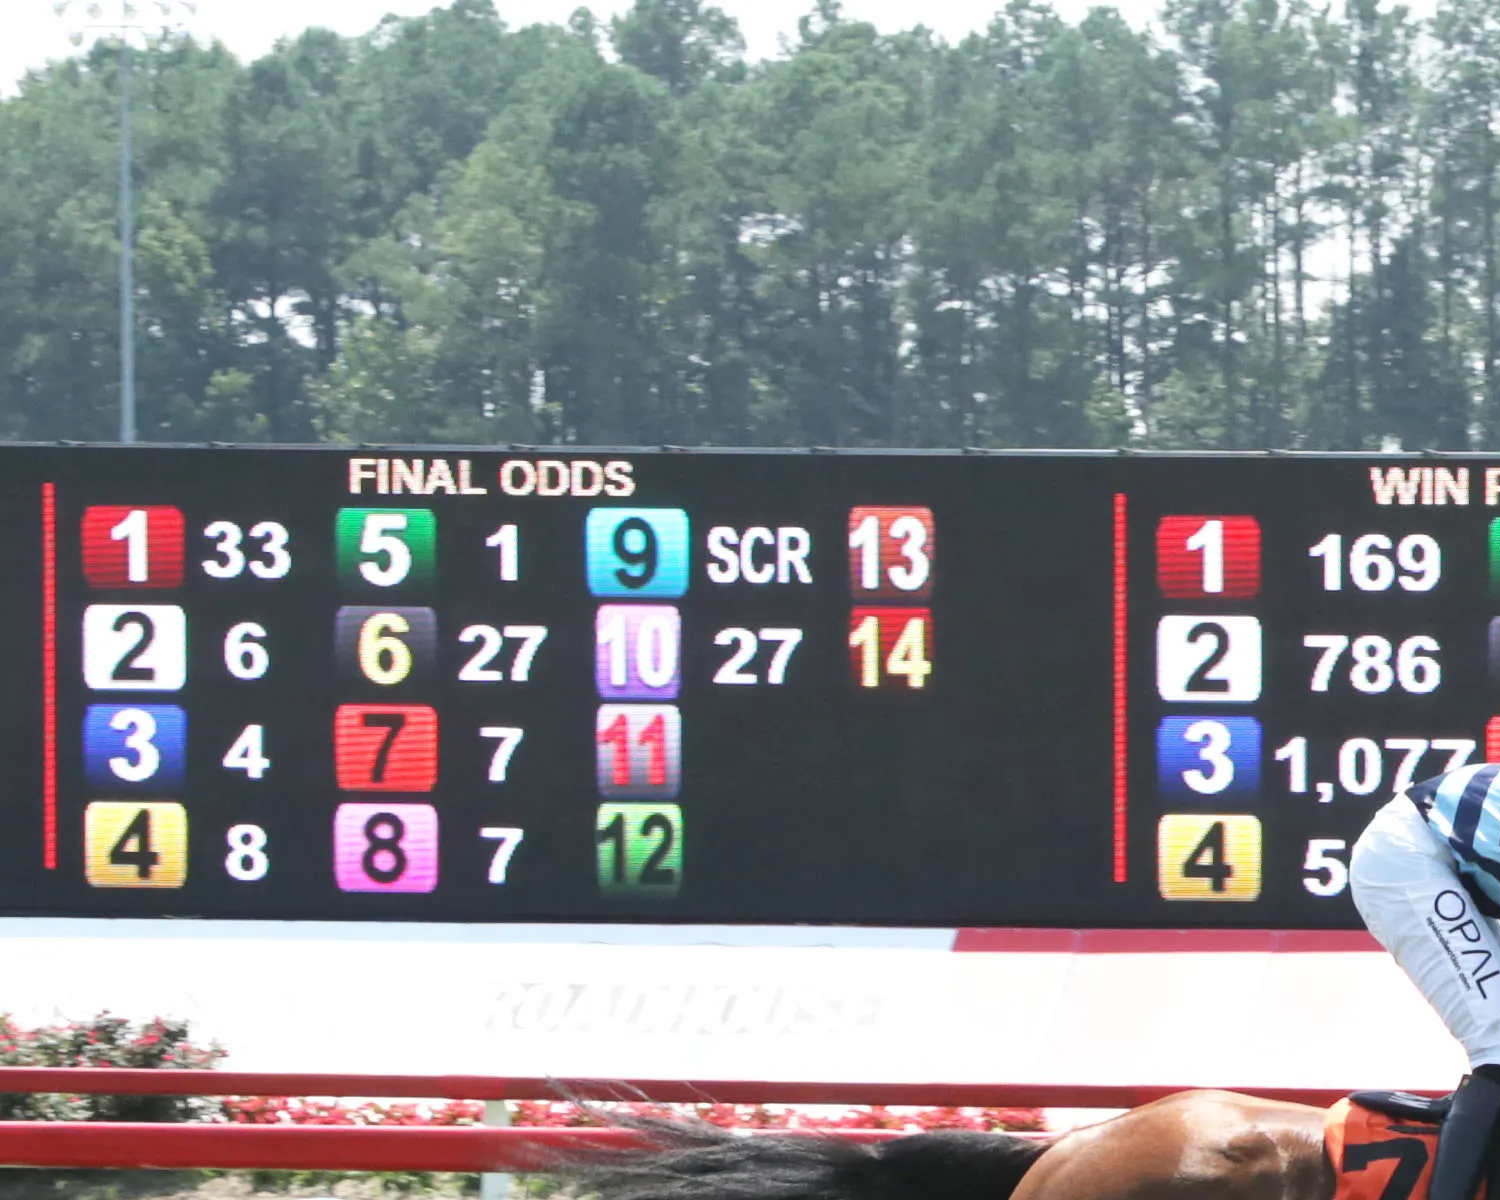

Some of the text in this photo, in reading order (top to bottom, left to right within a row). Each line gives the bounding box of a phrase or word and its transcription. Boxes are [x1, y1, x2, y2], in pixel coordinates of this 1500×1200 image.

[349, 459, 636, 498] FINAL ODDS
[1370, 467, 1471, 506] WIN
[109, 510, 932, 591] 1 33 5 1 9 SCR 13
[1185, 519, 1225, 594] 1
[1308, 533, 1442, 593] 169
[110, 611, 933, 689] 2 6 6 27 10 27 14
[1184, 622, 1231, 695] 2
[1303, 634, 1442, 695] 786
[108, 708, 667, 787] 3 4 7 7 11
[1182, 720, 1235, 795] 3
[1274, 736, 1477, 804] 1,077
[109, 808, 676, 887] 4 8 8 7 12
[1182, 820, 1235, 894] 4
